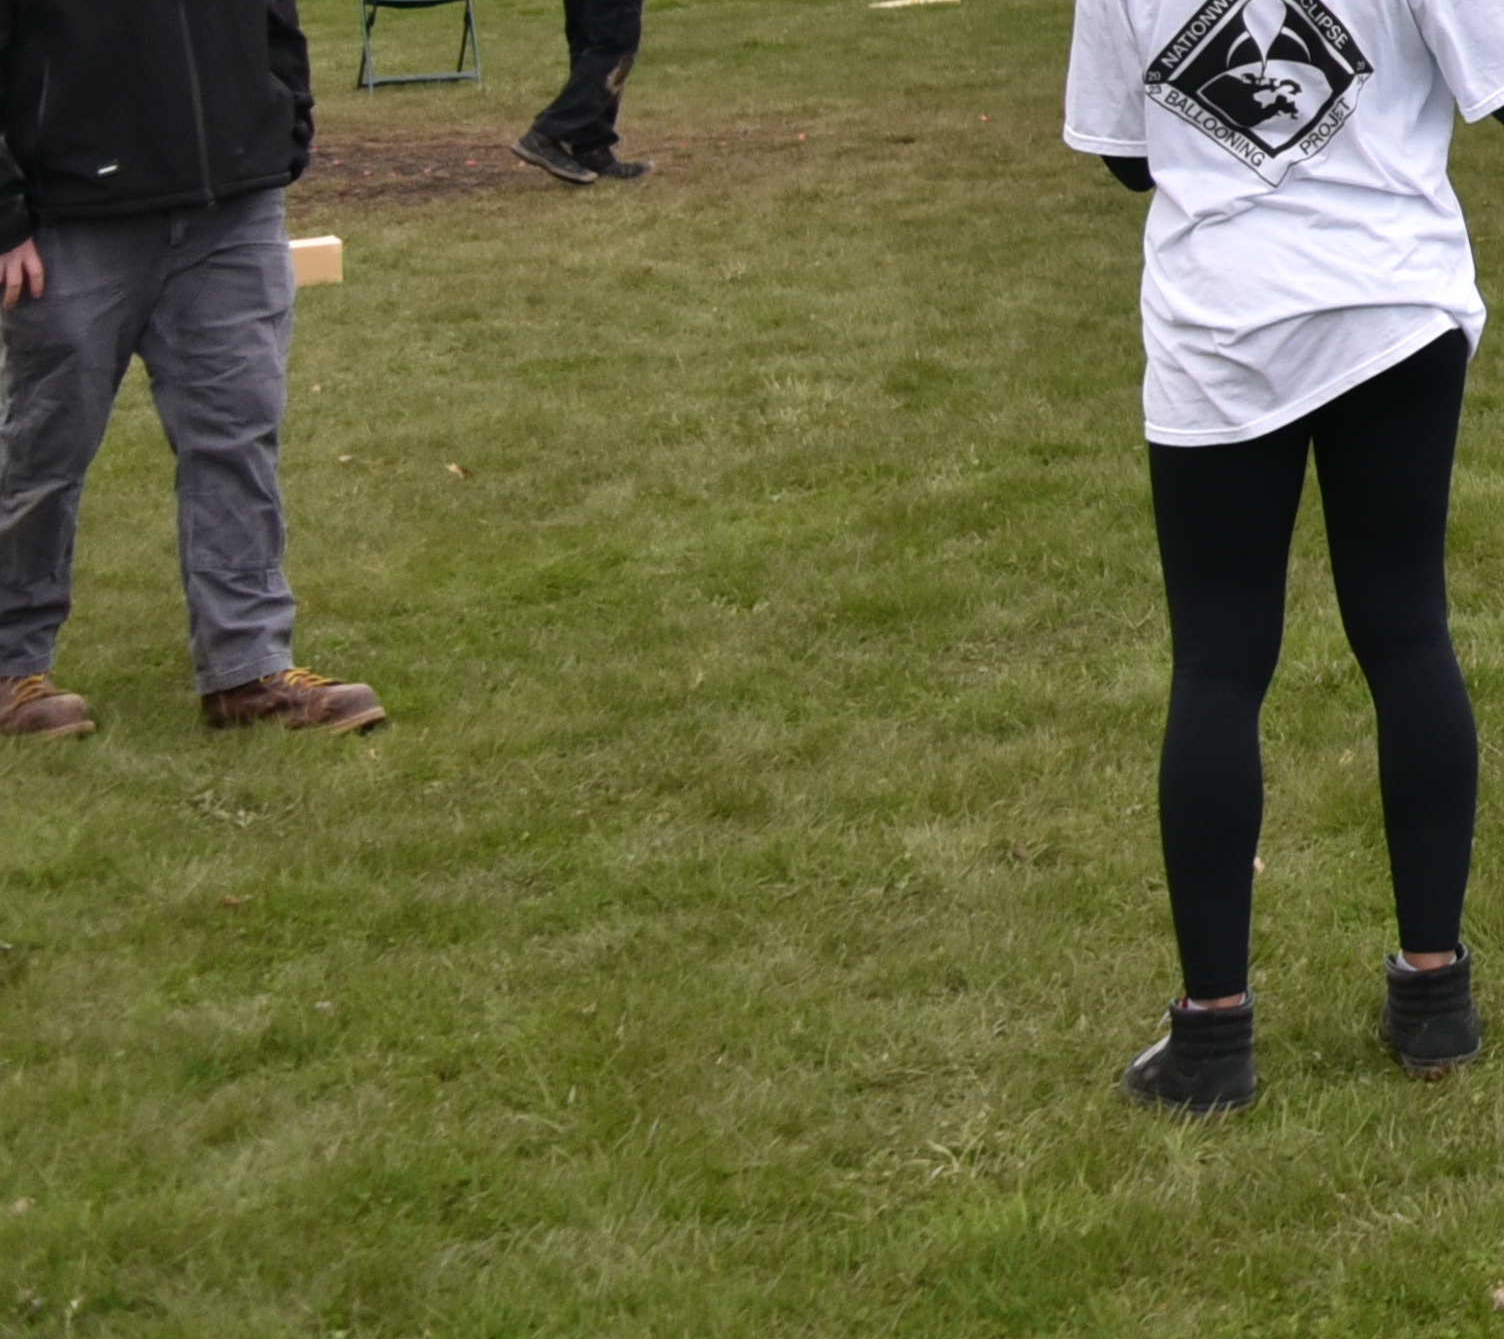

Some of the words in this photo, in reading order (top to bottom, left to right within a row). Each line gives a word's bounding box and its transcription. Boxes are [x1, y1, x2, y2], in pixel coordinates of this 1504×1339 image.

[1147, 70, 1161, 82] 20
[1163, 89, 1266, 167] BALLOONING
[1299, 96, 1351, 156] PROJET
